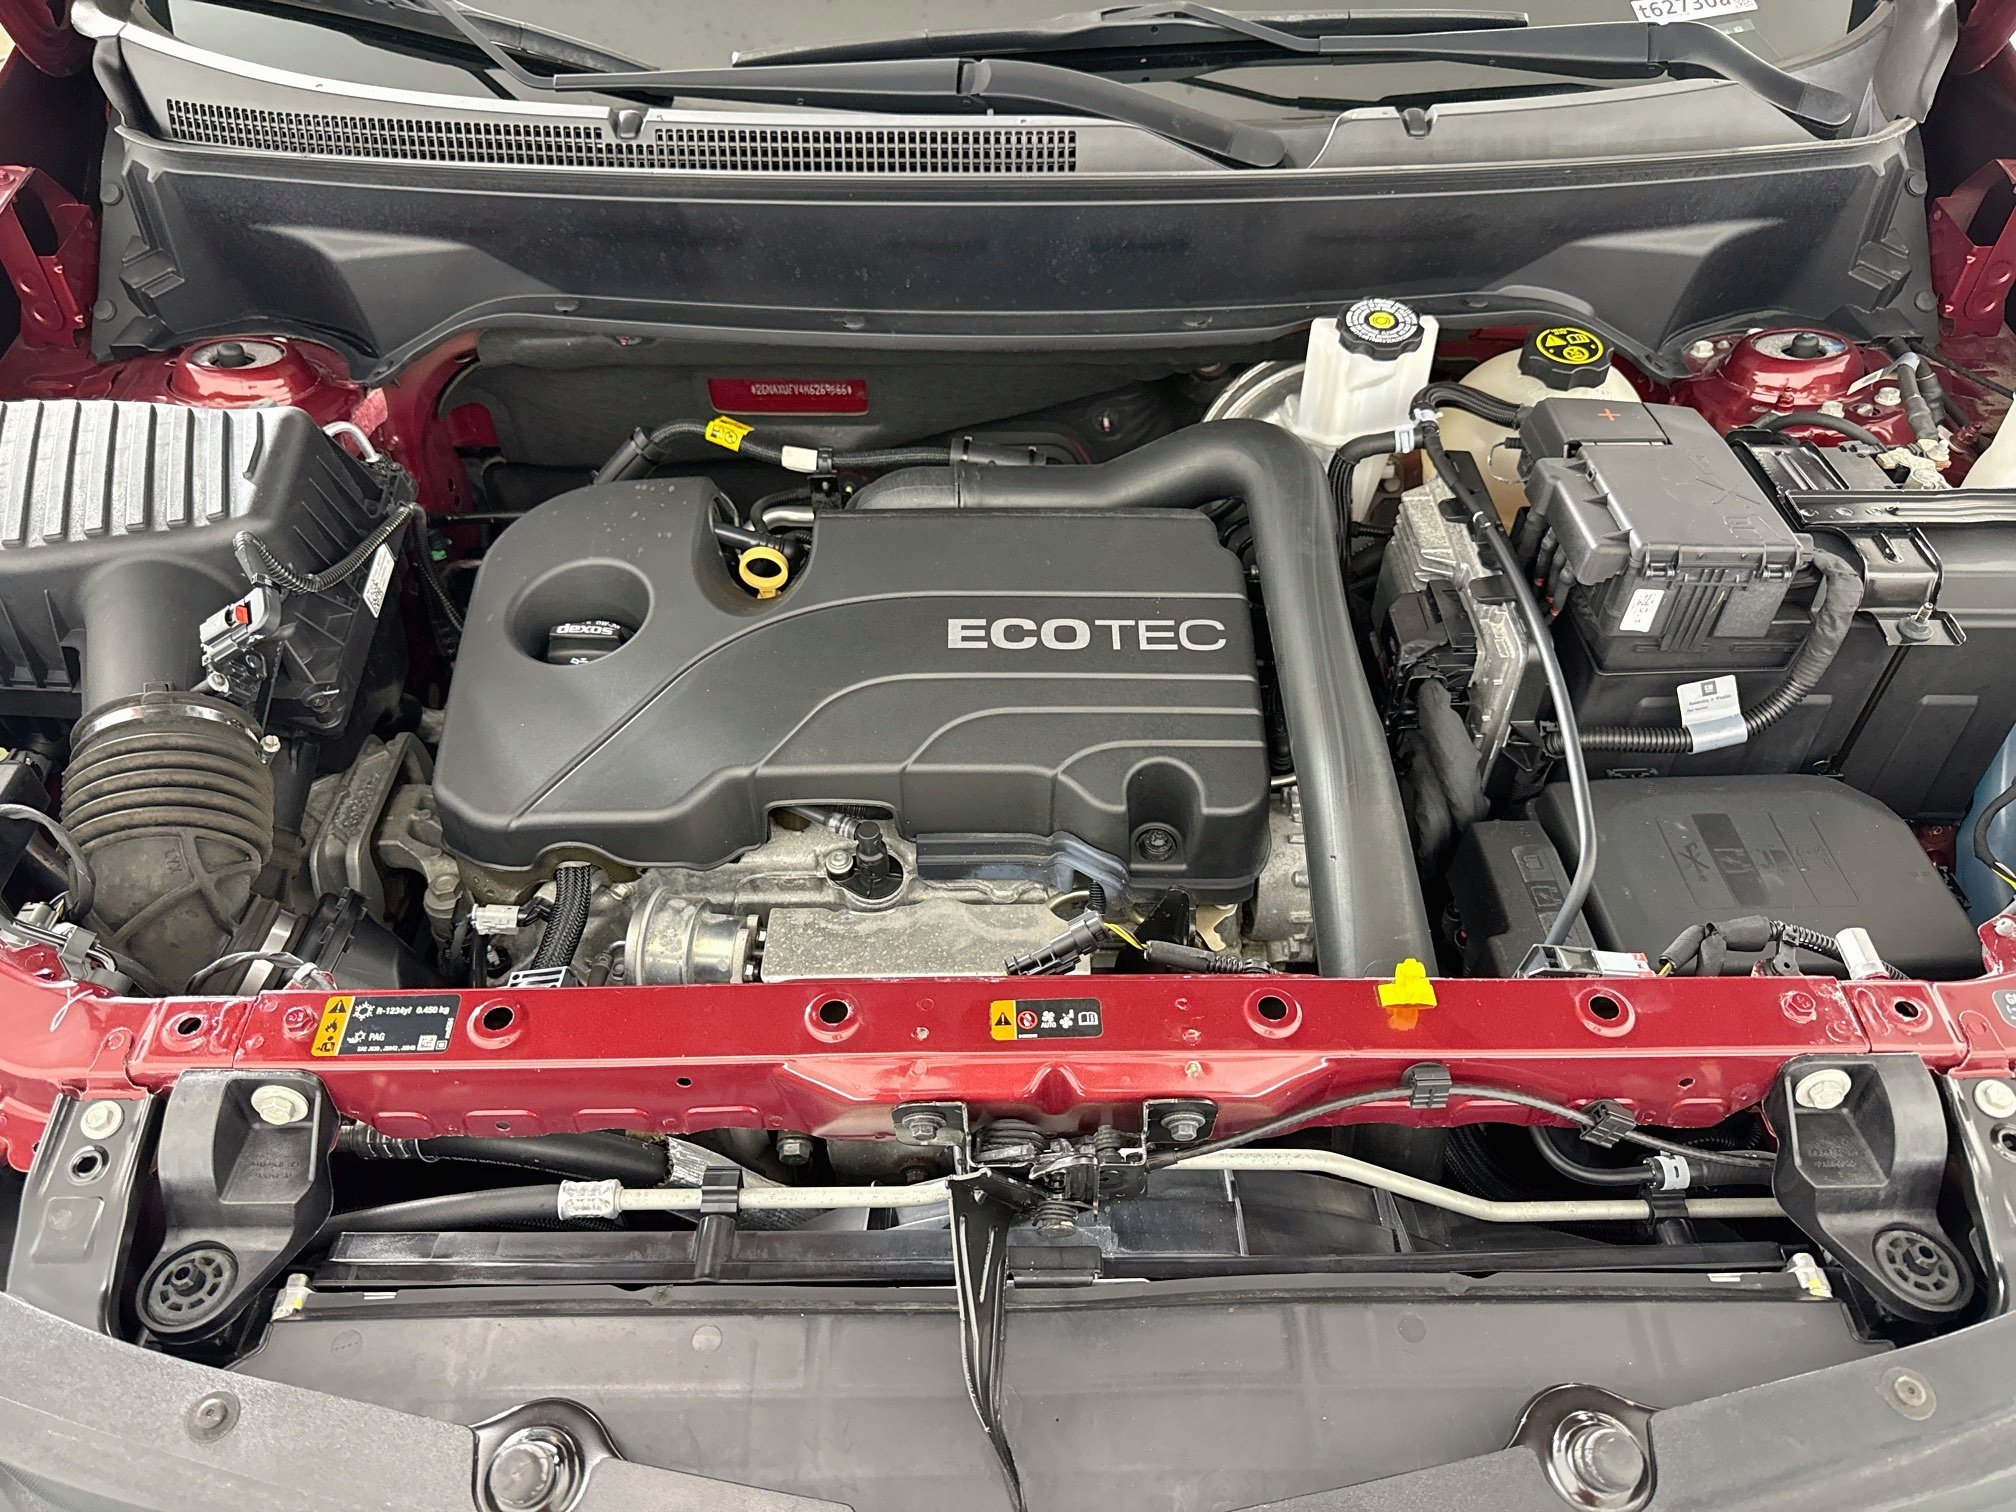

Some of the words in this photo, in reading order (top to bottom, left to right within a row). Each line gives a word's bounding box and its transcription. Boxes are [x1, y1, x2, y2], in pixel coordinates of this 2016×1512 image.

[557, 624, 614, 635] dexos
[947, 617, 1227, 650] ECOTEC
[376, 1006, 412, 1016] R-1234yf
[416, 1006, 437, 1015] 0.450
[439, 1006, 450, 1015] kg
[368, 1033, 386, 1041] PAG
